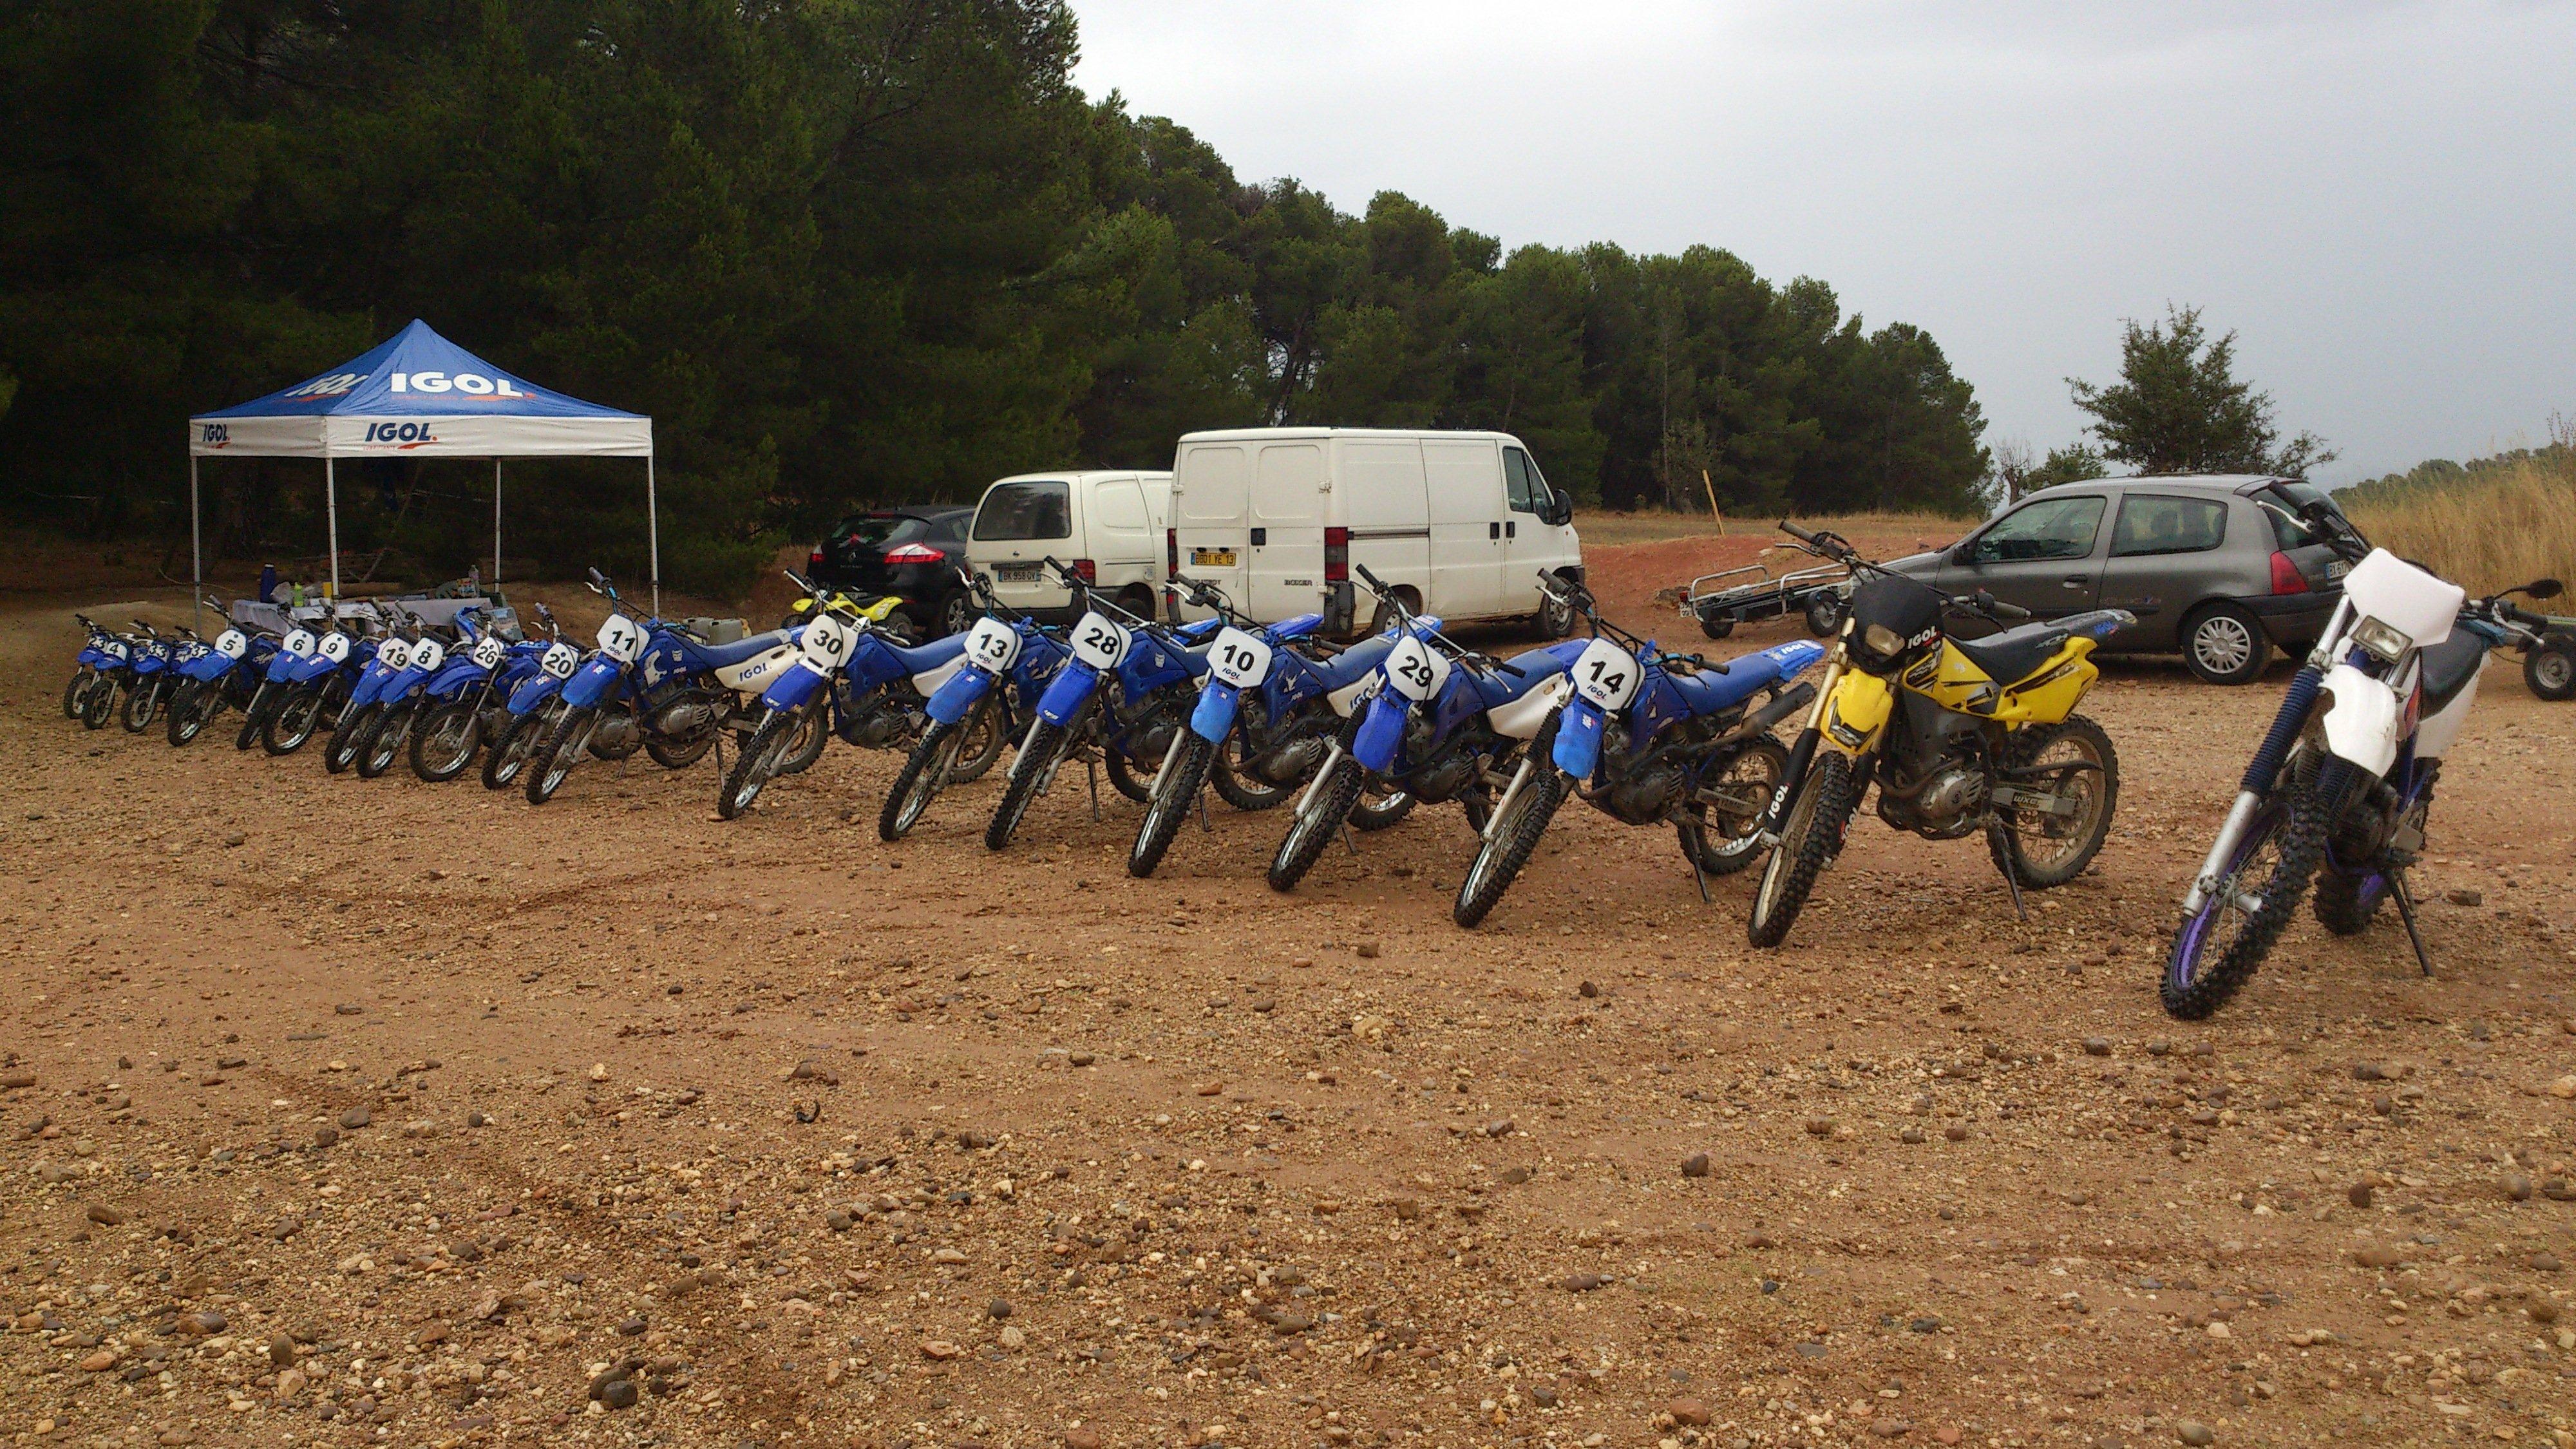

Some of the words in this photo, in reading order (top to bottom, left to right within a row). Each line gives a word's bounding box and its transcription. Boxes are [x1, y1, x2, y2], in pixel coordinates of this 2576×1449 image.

[1226, 555, 1234, 564] 13
[223, 639, 236, 651] 5
[293, 639, 305, 650] 6
[612, 630, 636, 652] 11
[813, 630, 842, 655] 30
[981, 634, 1007, 658] 13
[1084, 627, 1118, 655] 28
[1908, 625, 1937, 650] IGOL
[109, 644, 118, 654] 4
[326, 643, 338, 654] 9
[386, 649, 407, 667] 19
[417, 651, 431, 665] 8
[476, 645, 497, 664] 26
[1224, 645, 1255, 672] 10
[545, 653, 571, 674] 20
[1398, 656, 1434, 687] 29
[1591, 661, 1625, 695] 14
[1768, 785, 1790, 820] IGOL
